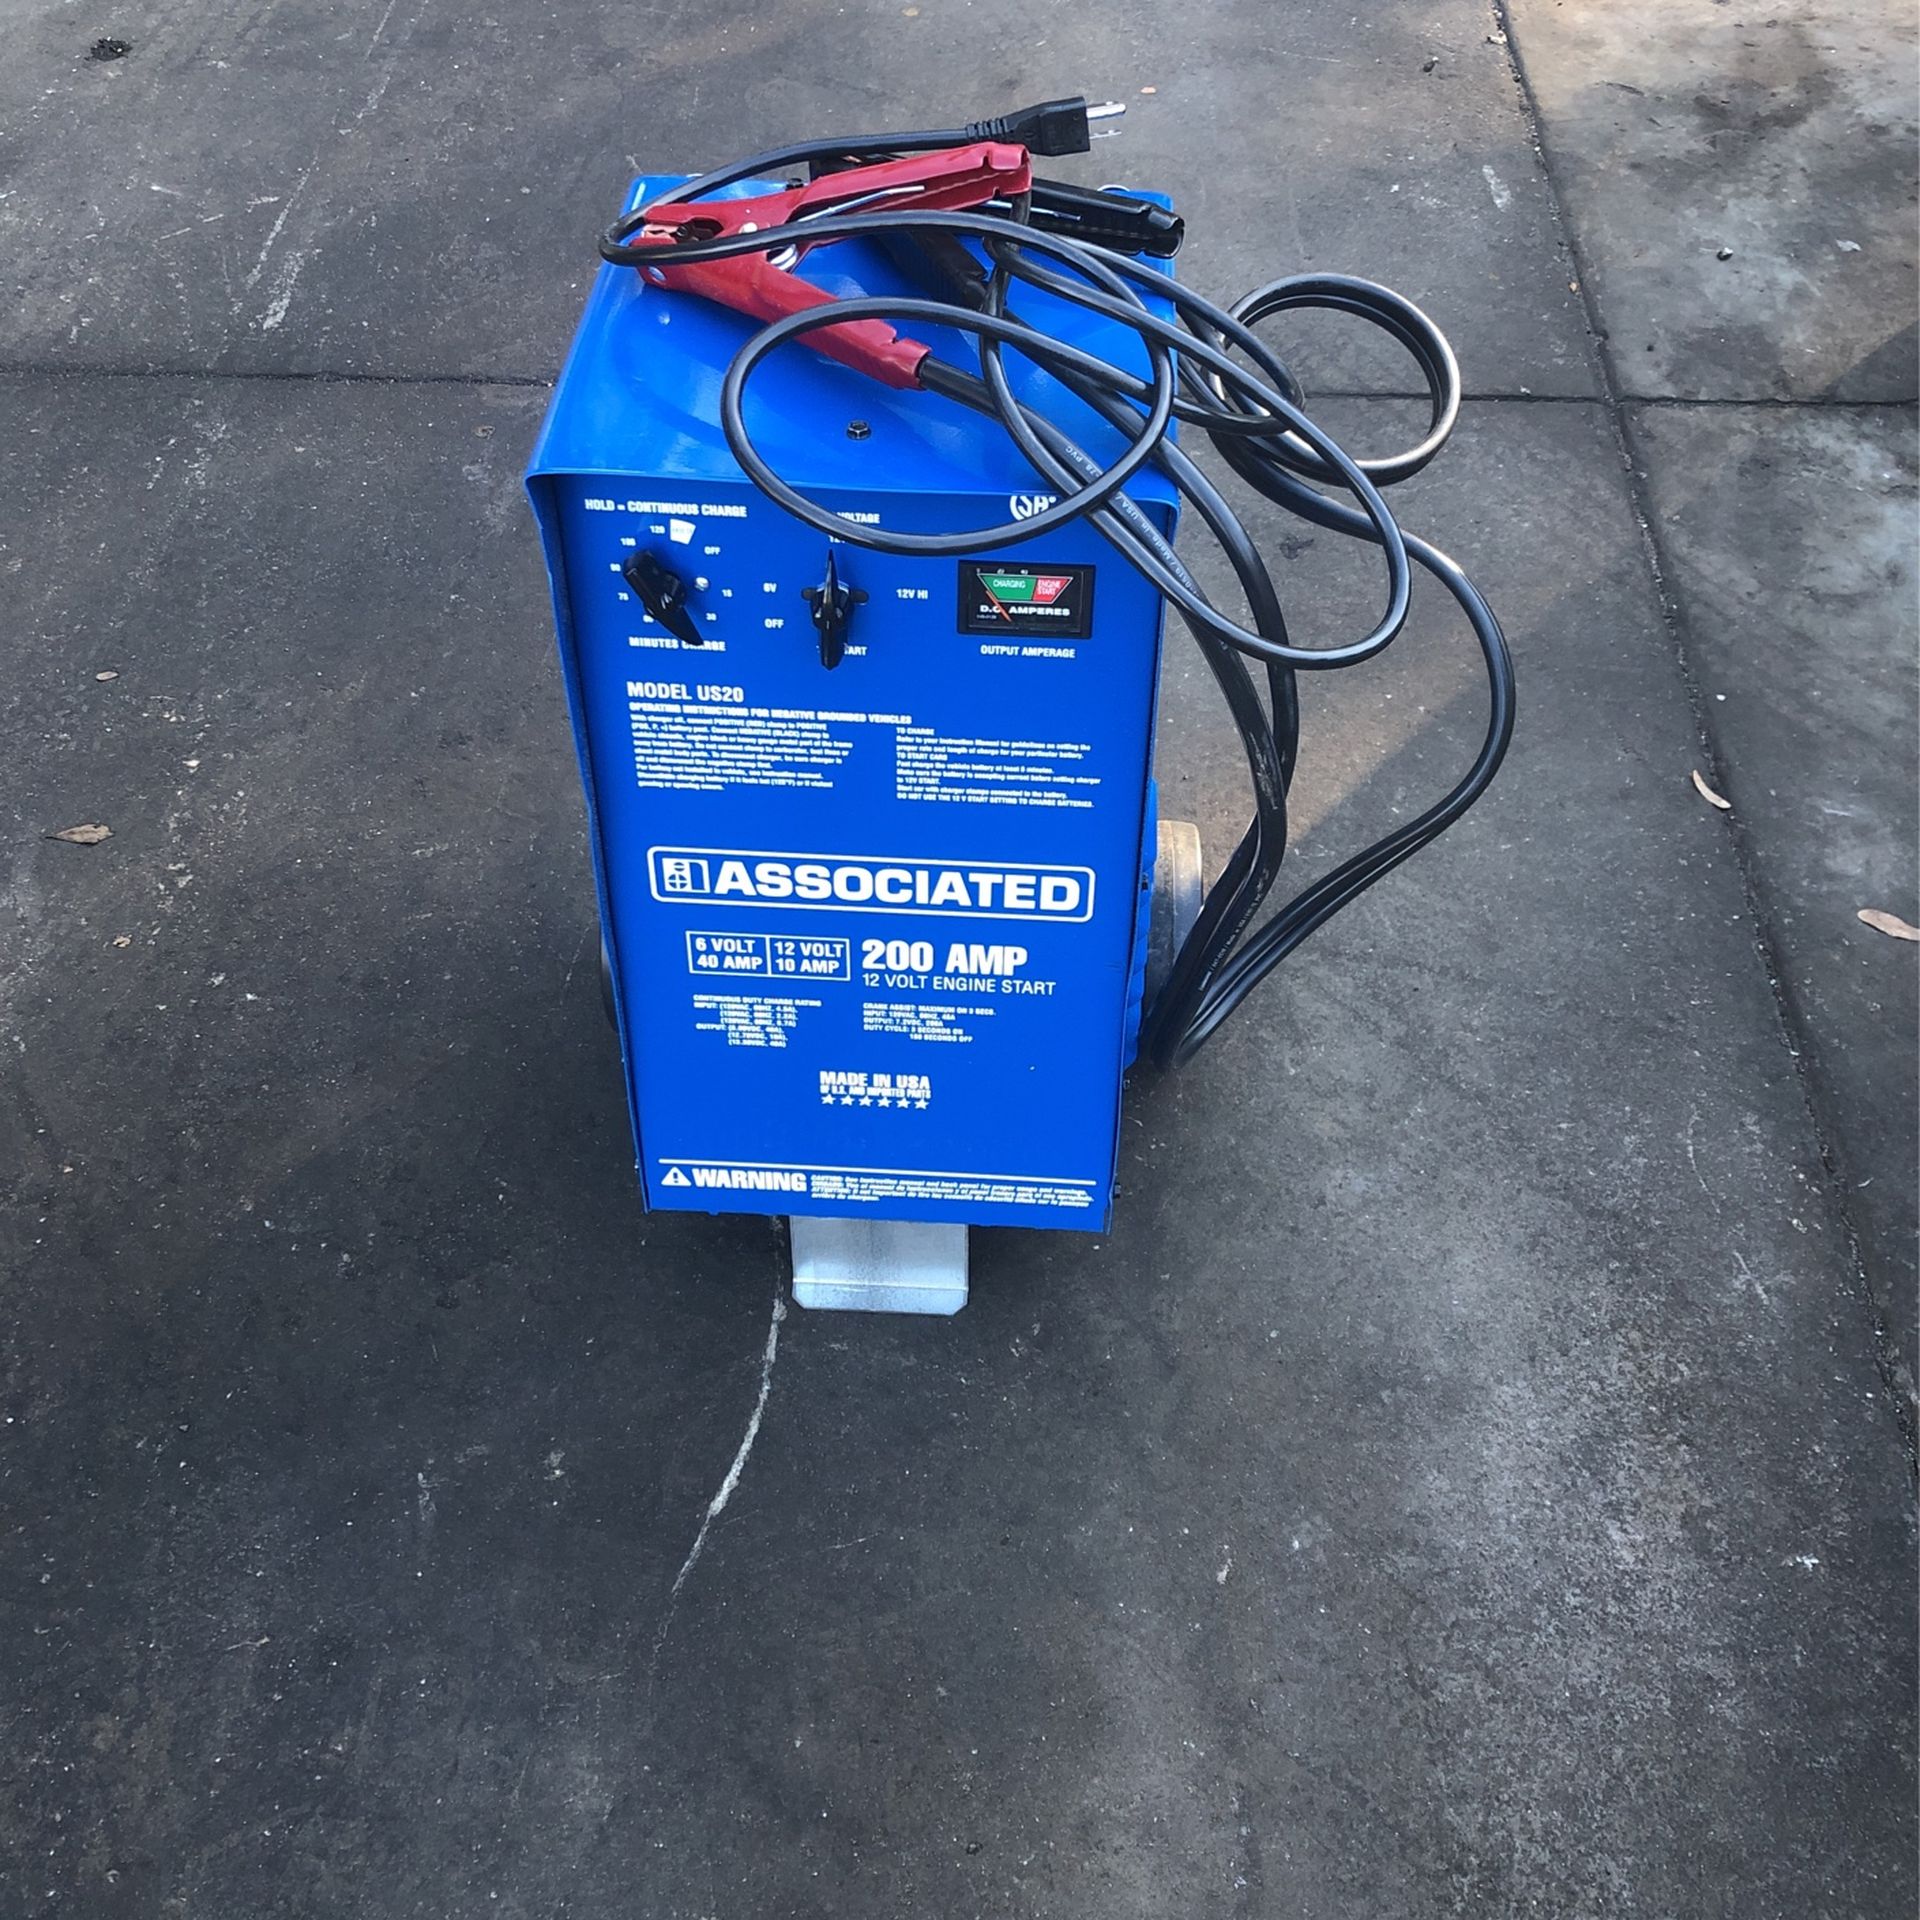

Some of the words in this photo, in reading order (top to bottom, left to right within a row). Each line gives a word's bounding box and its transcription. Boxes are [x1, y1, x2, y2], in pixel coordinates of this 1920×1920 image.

[584, 499, 615, 511] HOLD
[627, 501, 699, 515] CONTINUOUS
[701, 504, 747, 518] CHARGE
[1122, 501, 1139, 520] USA
[704, 547, 721, 555] OFF
[763, 583, 777, 592] 6V
[993, 579, 1026, 589] CHARGING
[1037, 587, 1056, 595] START
[896, 589, 915, 599] 12V
[917, 590, 928, 599] HI
[1008, 606, 1071, 616] AMPERES
[764, 619, 784, 628] OFF
[629, 636, 678, 649] MINUTES
[980, 645, 1020, 655] OUTPUT
[1022, 646, 1076, 658] AMPERAGE
[626, 681, 693, 700] MODEL
[697, 685, 744, 702] US20
[750, 708, 769, 718] FOR
[771, 709, 816, 720] NEGATIVE
[868, 713, 912, 724] VEHICLES
[714, 861, 1080, 912] ASSOCIATED
[695, 937, 707, 951] 6
[710, 938, 755, 953] VOLT
[774, 941, 795, 956] 12
[800, 942, 844, 957] VOLT
[697, 954, 718, 968] 40
[723, 956, 763, 970] AMP
[861, 938, 934, 972] 200
[945, 943, 1027, 976] AMP
[775, 958, 796, 972] 10
[800, 959, 840, 974] AMP
[862, 973, 880, 987] 12
[885, 974, 928, 989] VOLT
[933, 976, 996, 993] ENGINE
[1001, 980, 1056, 995] START
[917, 1027, 951, 1035] SECONDS
[924, 1034, 957, 1042] SECONDS
[820, 1071, 868, 1086] MADE
[873, 1073, 891, 1088] IN
[896, 1075, 930, 1090] USA
[692, 1168, 807, 1192] WARNING
